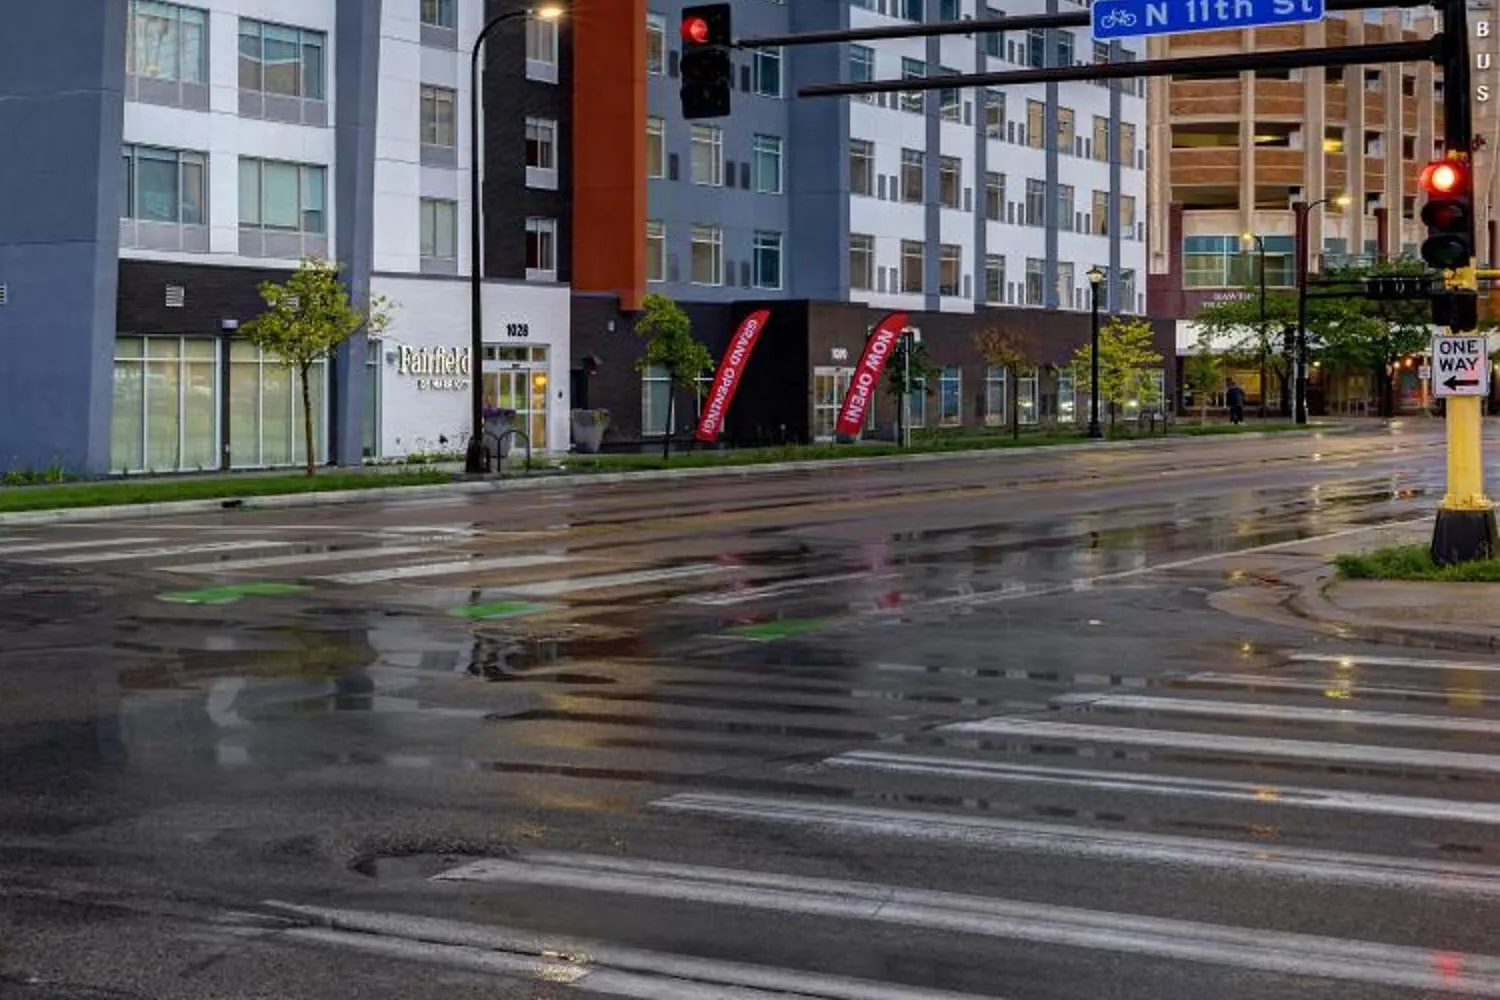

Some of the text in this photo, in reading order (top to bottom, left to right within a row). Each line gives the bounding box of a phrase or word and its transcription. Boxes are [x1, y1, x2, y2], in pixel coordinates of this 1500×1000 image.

[1146, 2, 1168, 27] N
[1476, 20, 1491, 102] BUS
[398, 345, 472, 376] Fairfield
[1440, 339, 1479, 355] ONE
[844, 329, 896, 424] NOW OPEN!
[1439, 357, 1479, 373] WAY
